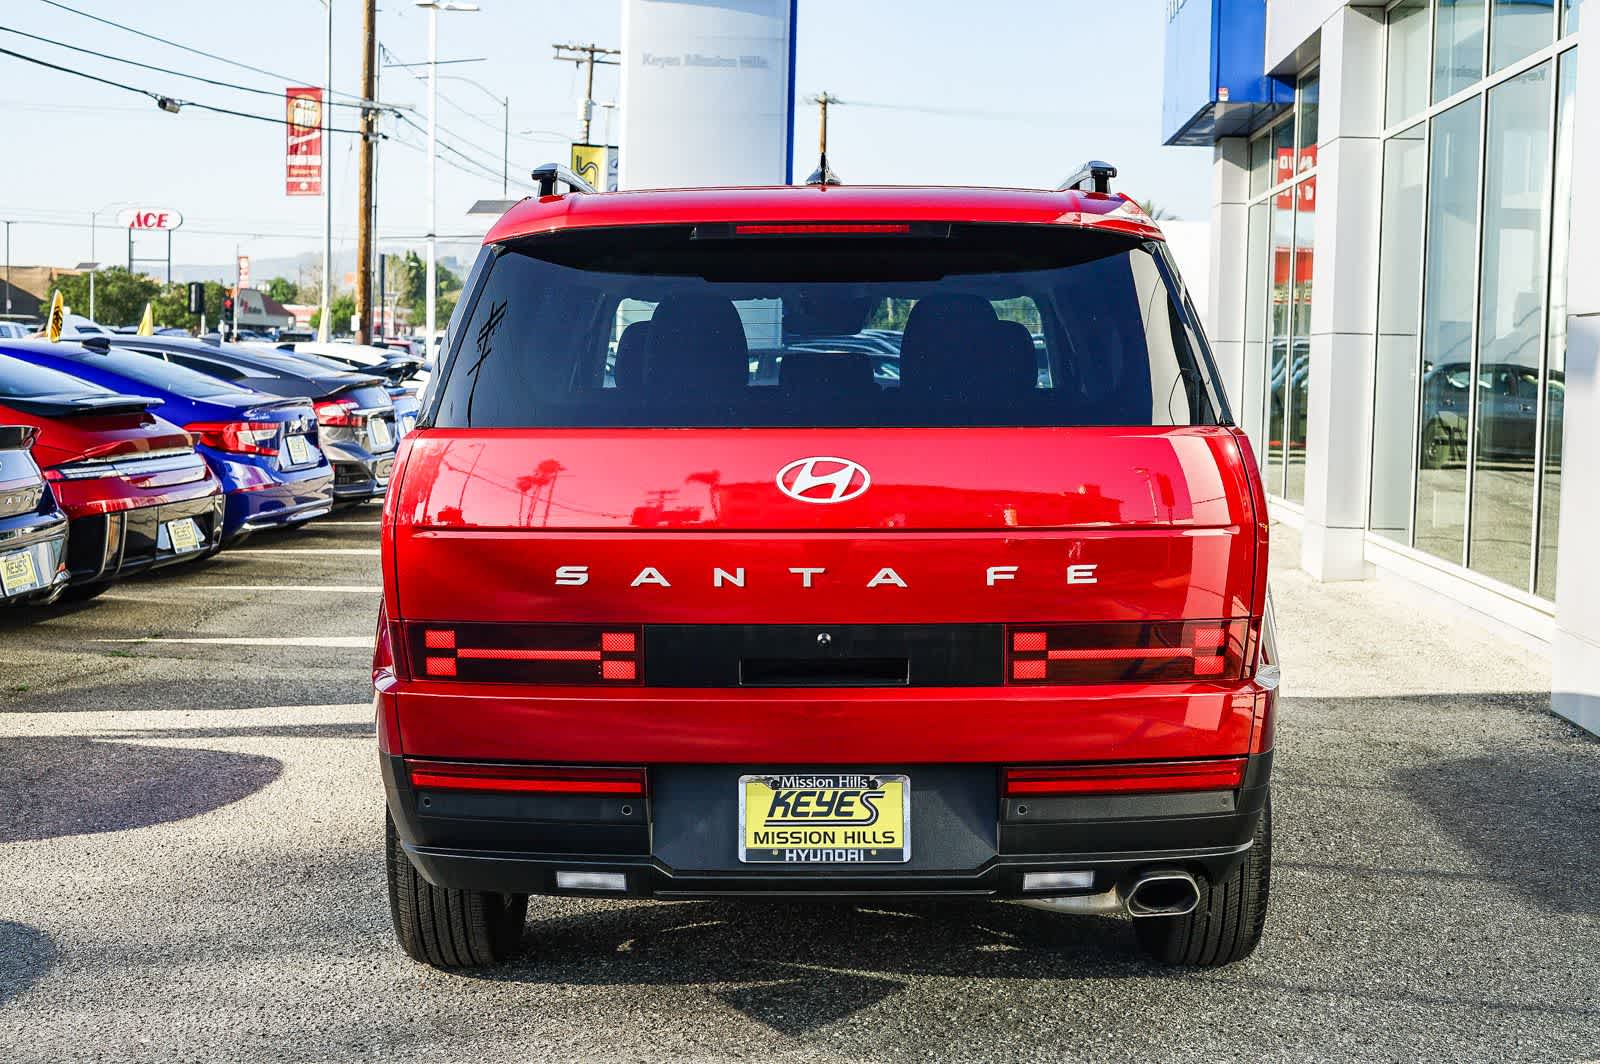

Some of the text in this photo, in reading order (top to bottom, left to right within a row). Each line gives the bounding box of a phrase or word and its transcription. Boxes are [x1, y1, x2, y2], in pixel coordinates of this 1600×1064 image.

[642, 53, 681, 69] Keyes
[130, 210, 169, 228] ACE
[555, 564, 1098, 588] SANTA FE
[781, 776, 868, 789] Mission Hills
[764, 790, 885, 827] KEYES
[753, 831, 895, 845] MISSION HILLS
[785, 849, 864, 862] HYUNDAI
